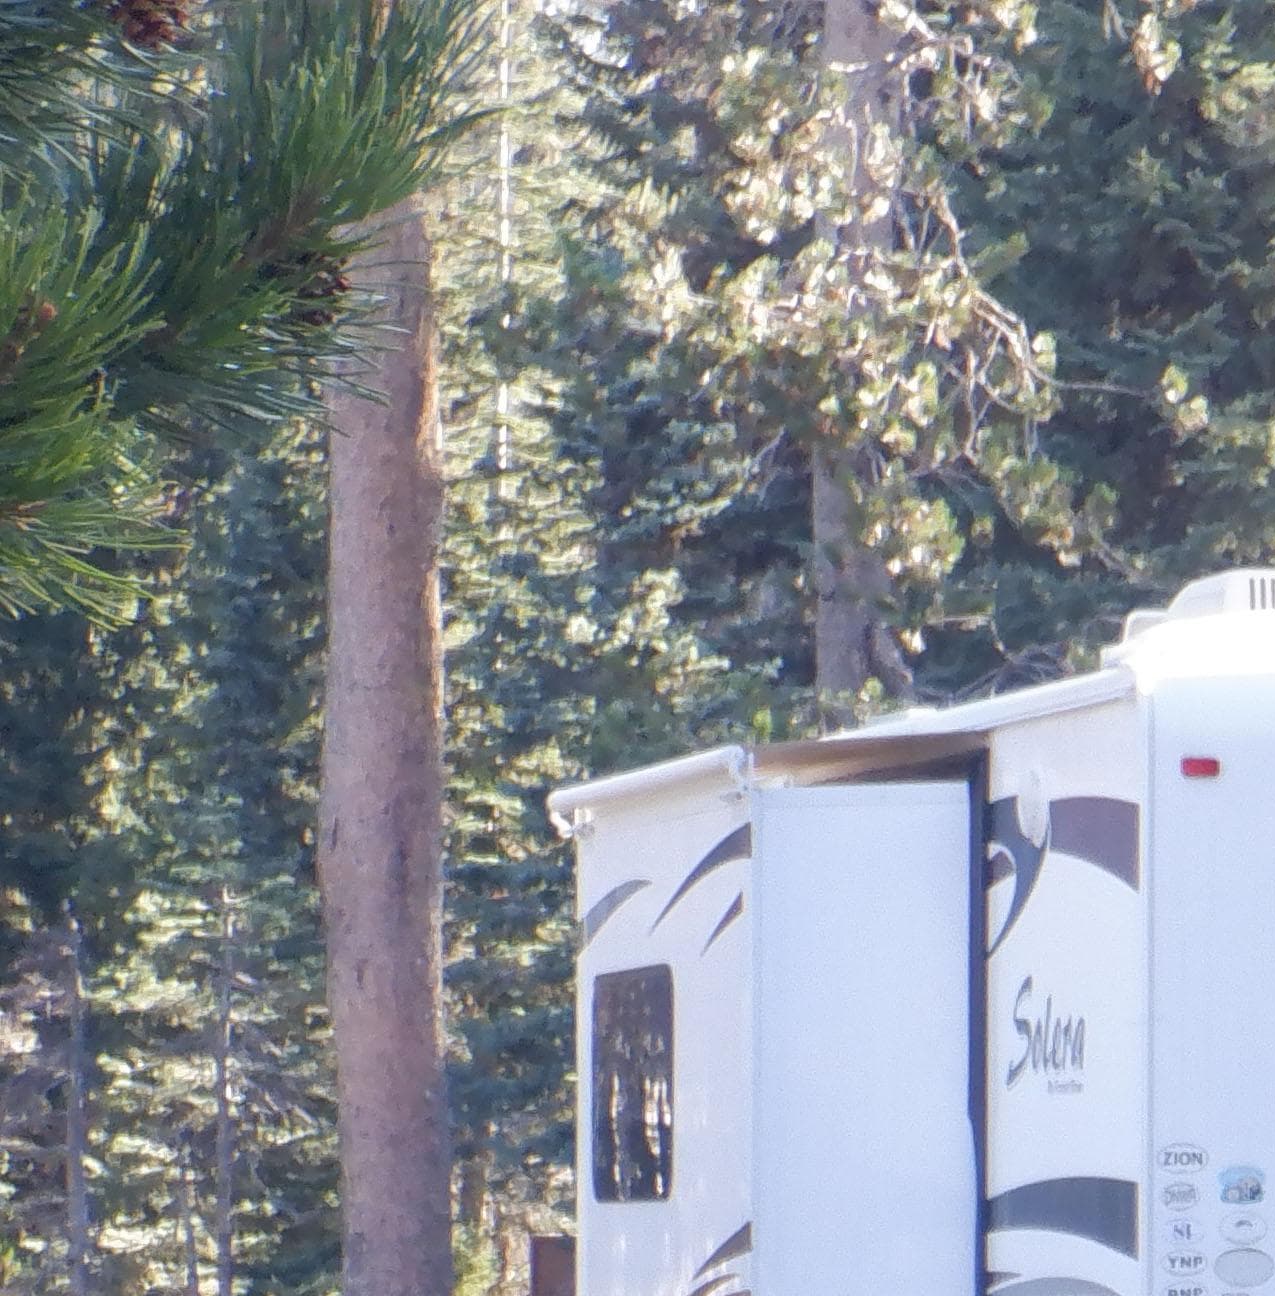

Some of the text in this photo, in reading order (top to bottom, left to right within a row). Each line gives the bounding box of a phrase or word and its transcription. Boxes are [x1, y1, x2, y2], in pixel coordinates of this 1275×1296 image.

[1006, 974, 1086, 1088] Solera
[1163, 1151, 1204, 1166] ZION
[1168, 1256, 1203, 1269] YNP
